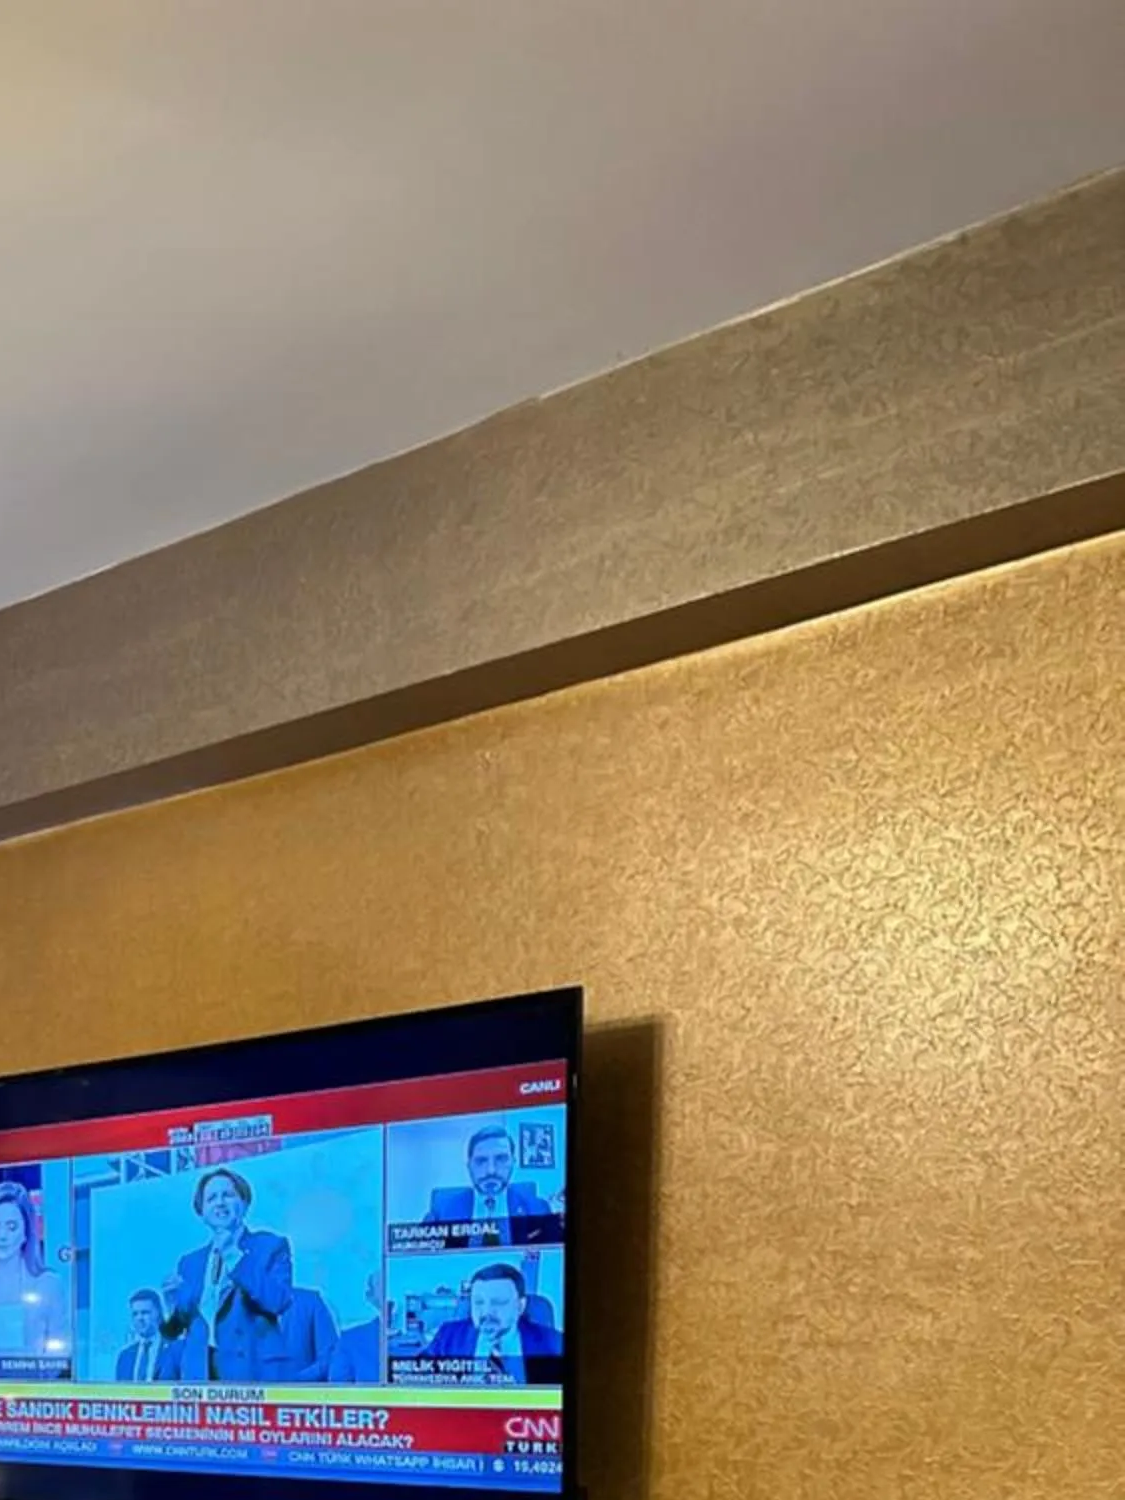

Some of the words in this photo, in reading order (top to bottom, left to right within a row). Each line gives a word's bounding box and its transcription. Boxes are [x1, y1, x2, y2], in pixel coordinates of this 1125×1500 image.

[520, 1079, 561, 1095] CANLI
[172, 1387, 203, 1401] SON
[206, 1388, 266, 1402] DURUM
[6, 1399, 74, 1419] SANDIK
[77, 1399, 200, 1425] DENKLEMİNİ
[206, 1404, 271, 1427] NASIL
[277, 1404, 390, 1430] ETKİLER?
[505, 1416, 560, 1439] CNN
[336, 1432, 414, 1449] ALACAK?
